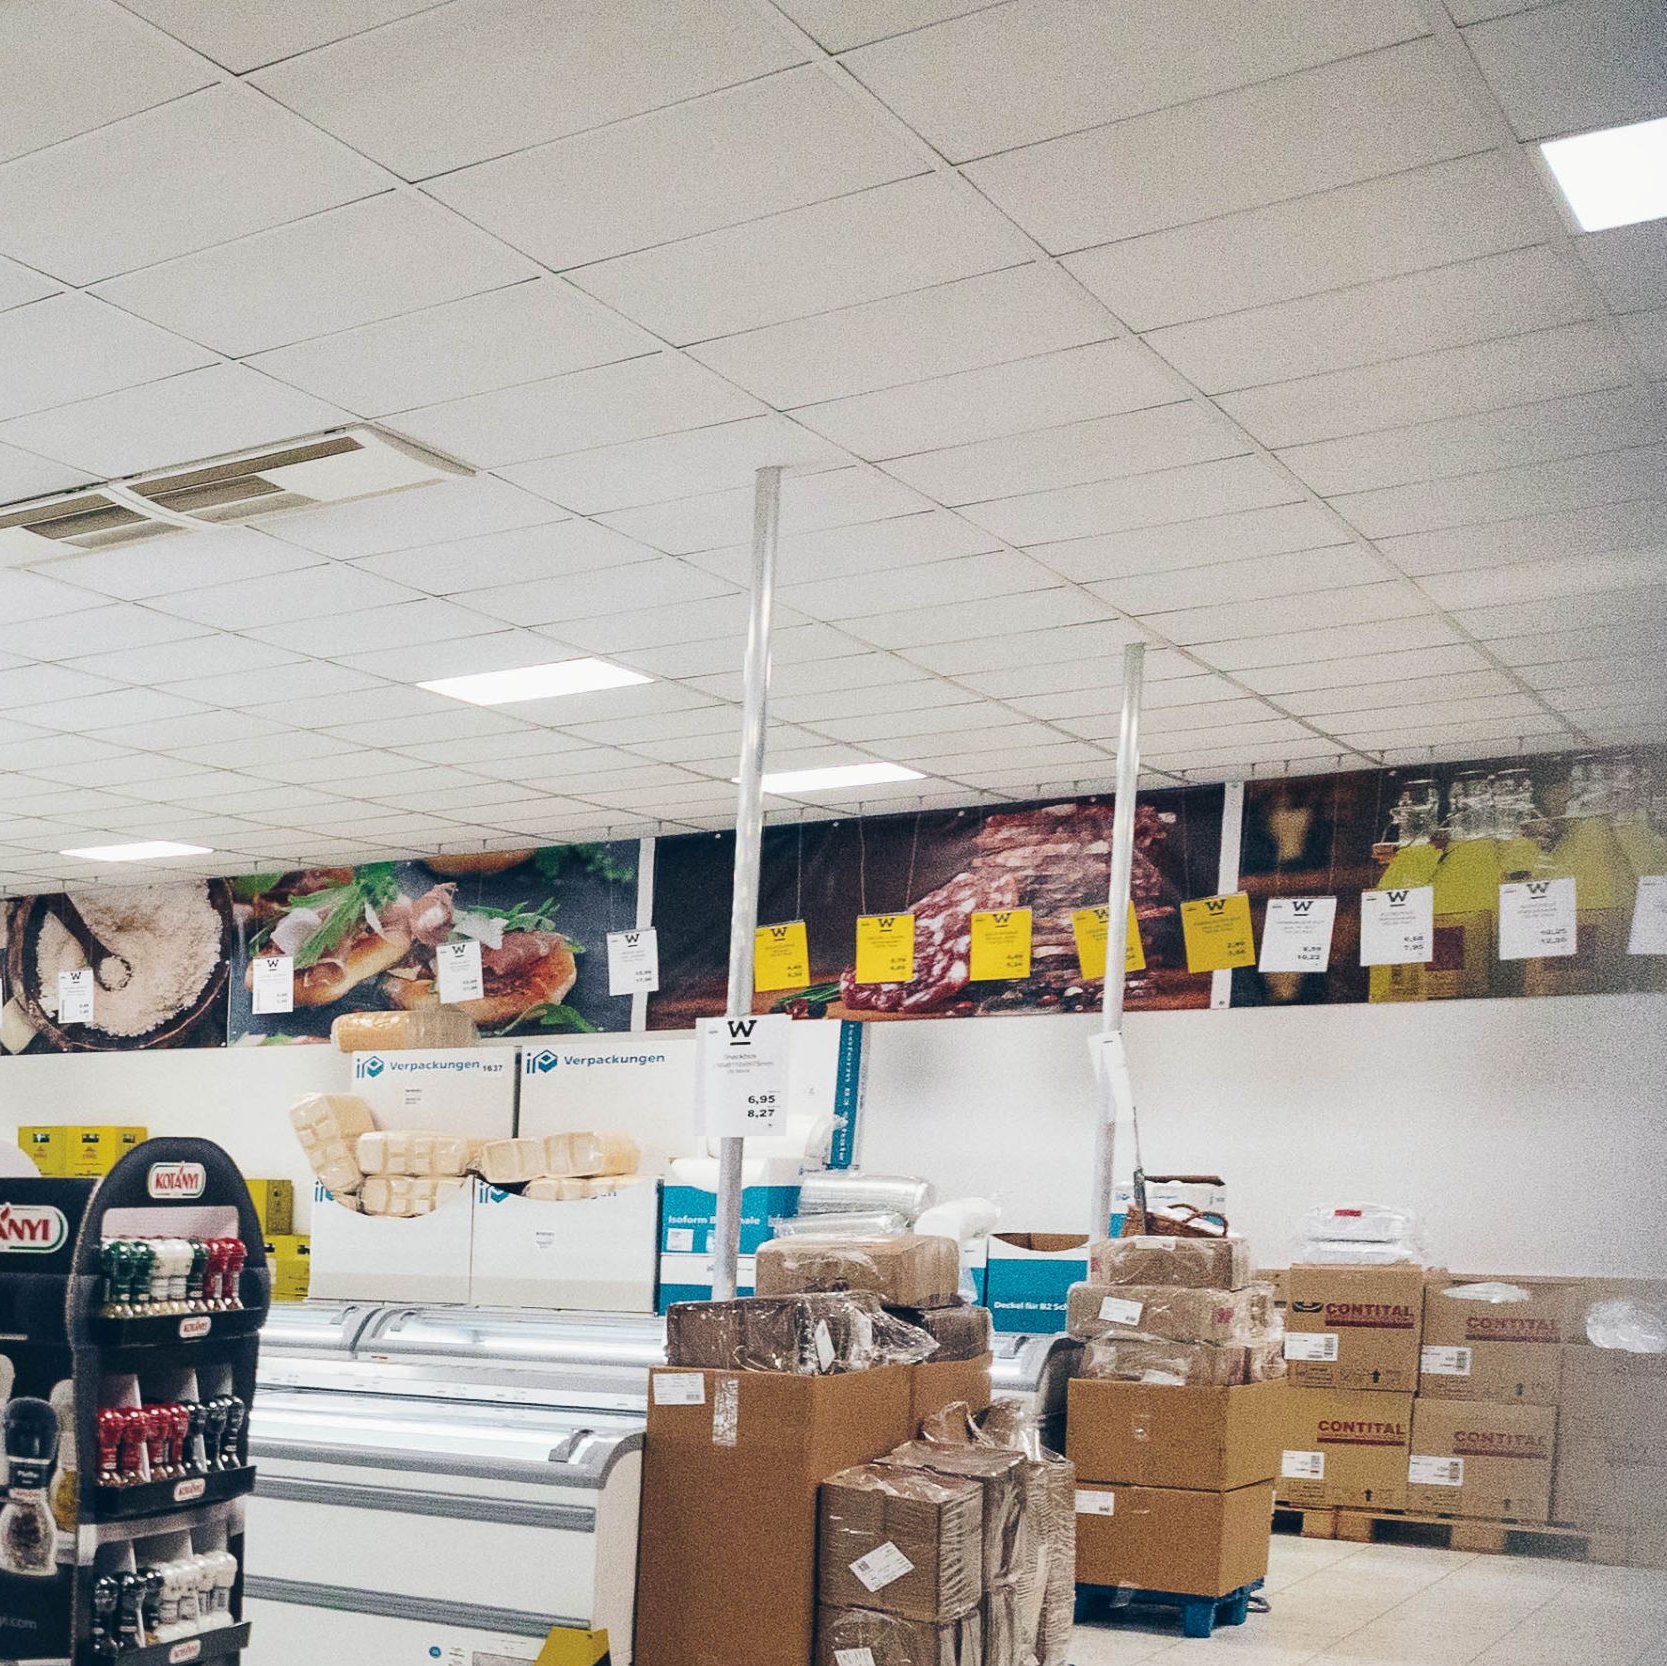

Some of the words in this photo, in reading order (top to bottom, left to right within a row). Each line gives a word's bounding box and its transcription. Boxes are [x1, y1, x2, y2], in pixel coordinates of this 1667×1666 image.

[1527, 882, 1550, 895] W
[1387, 890, 1409, 902] W
[1205, 899, 1227, 911] W
[1292, 901, 1314, 912] W
[728, 1020, 757, 1038] W
[389, 1060, 480, 1074] Verpackungen
[482, 1064, 503, 1072] 1637
[563, 1053, 665, 1069] Verpackungen
[748, 1095, 776, 1105] 6,95
[747, 1109, 775, 1118] 8,27
[668, 1214, 708, 1224] Isoform
[993, 1301, 1024, 1310] Deckel
[1026, 1301, 1038, 1310] für
[1325, 1303, 1414, 1317] CONTITAL
[1467, 1316, 1557, 1332] CONTITAL
[1318, 1420, 1405, 1435] CONTITAL
[1454, 1430, 1545, 1446] CONTITAL
